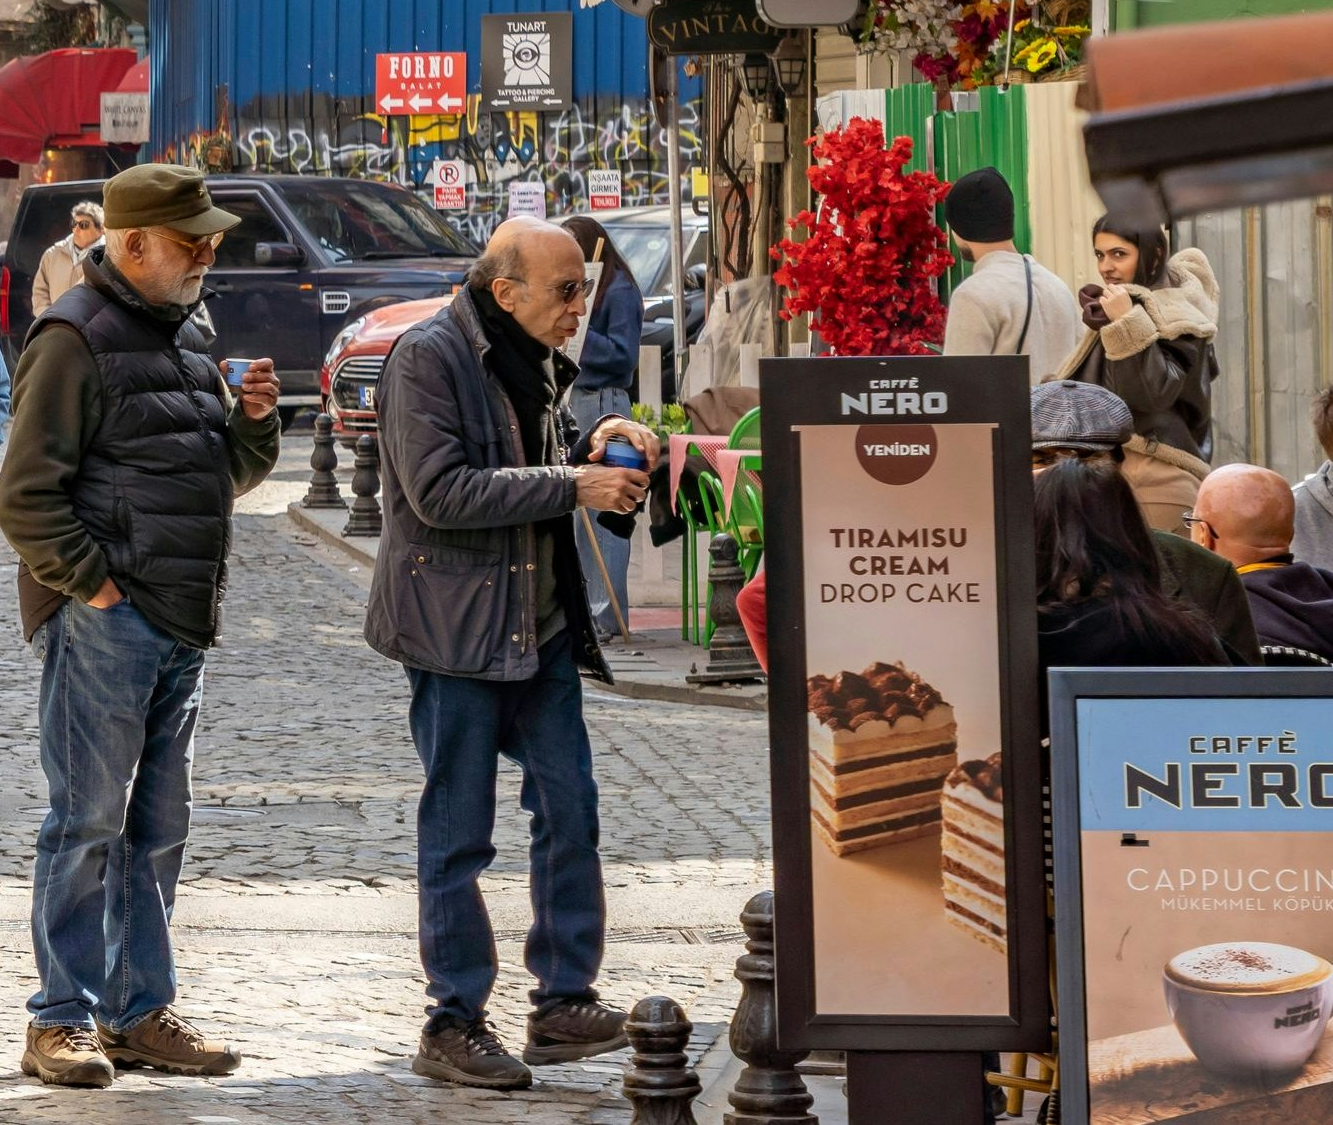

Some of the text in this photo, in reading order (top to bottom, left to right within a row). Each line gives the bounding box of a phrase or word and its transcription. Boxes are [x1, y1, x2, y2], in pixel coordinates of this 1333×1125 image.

[507, 21, 546, 32] TUNART
[660, 13, 780, 43] VINTAG
[389, 55, 454, 79] FORNO
[400, 82, 442, 90] BALAT
[497, 89, 521, 97] TATTOO
[513, 95, 539, 103] GALLERY
[869, 377, 920, 389] CAFFÈ
[840, 391, 949, 416] NERO
[862, 441, 931, 457] YENİDEN
[829, 527, 968, 549] TIRAMISU
[849, 555, 950, 576] CREAM
[820, 582, 981, 604] DROP CAKE
[1188, 730, 1298, 755] CAFFÈ
[1161, 895, 1266, 912] MÜKEMMEL
